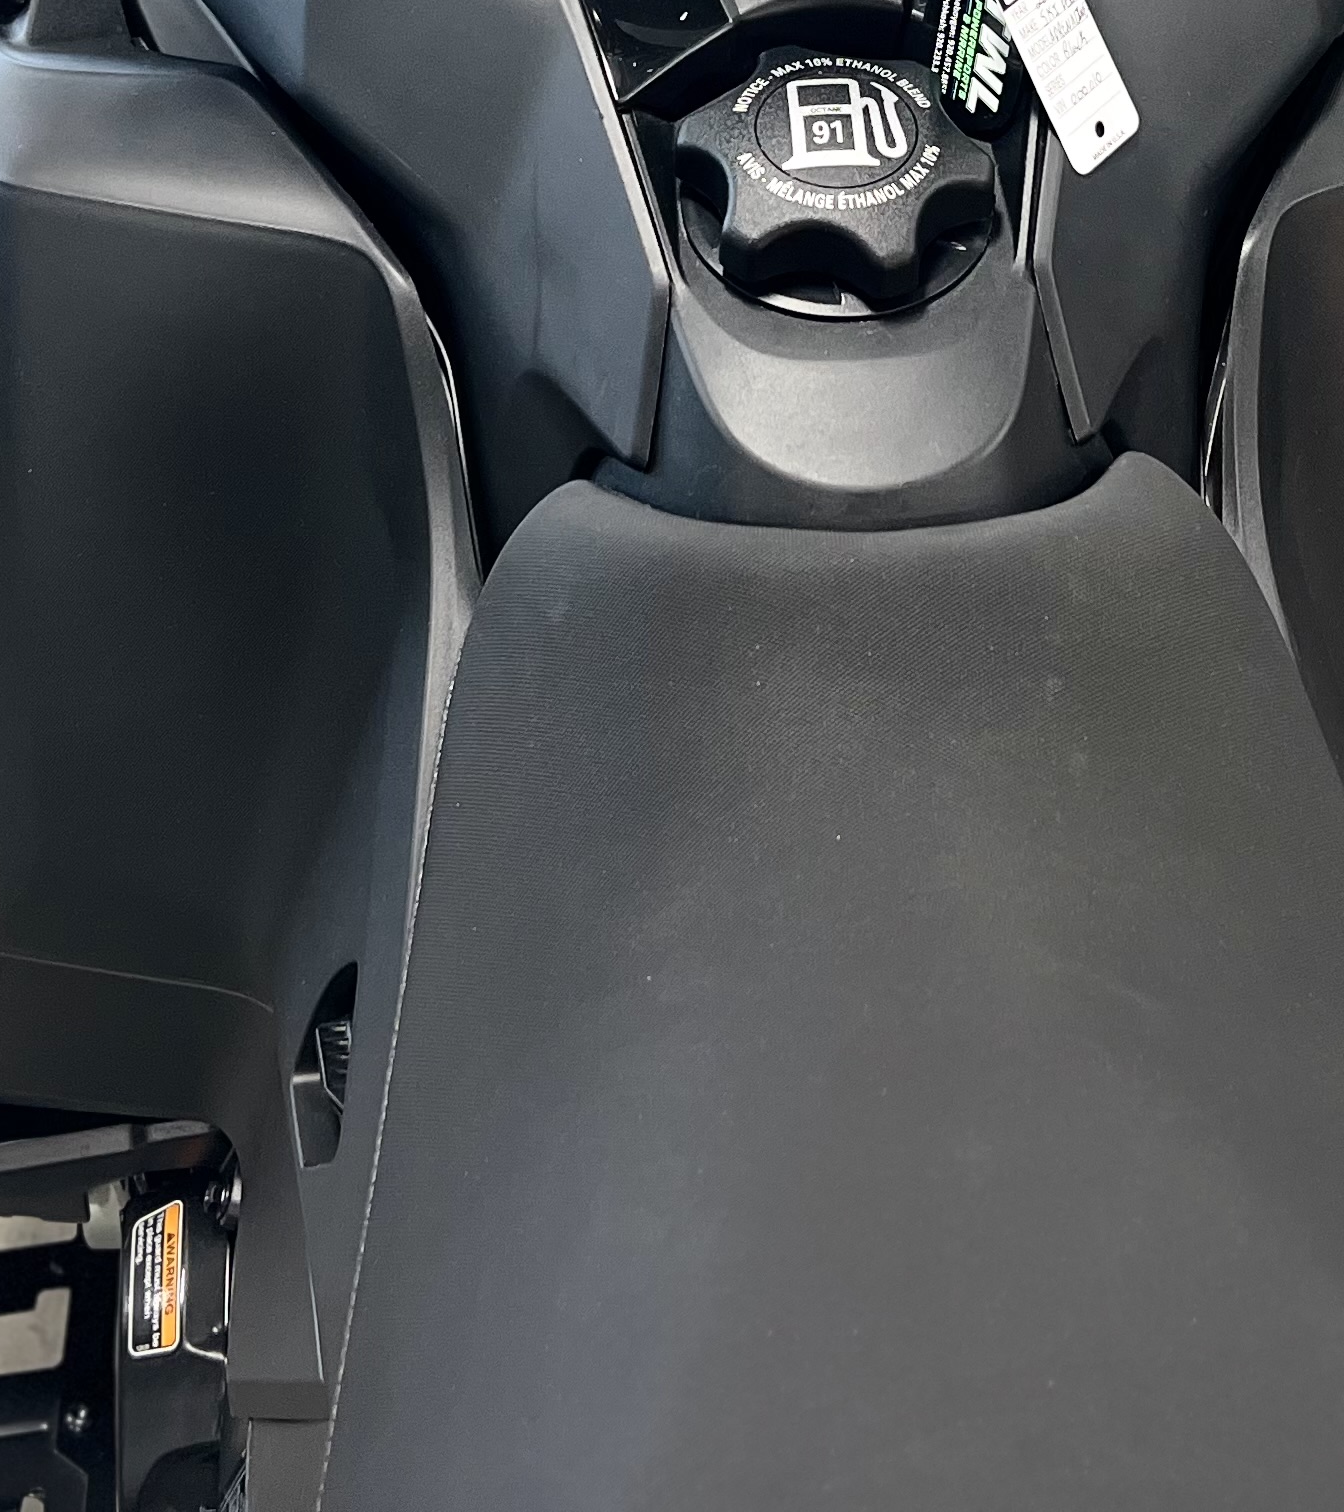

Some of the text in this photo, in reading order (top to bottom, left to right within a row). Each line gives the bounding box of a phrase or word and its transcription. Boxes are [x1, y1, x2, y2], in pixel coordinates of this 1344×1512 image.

[953, 25, 969, 80] MARINE
[958, 0, 983, 100] POWERSPORTS
[732, 78, 770, 112] NOTICE
[771, 61, 805, 77] MAX
[836, 58, 897, 82] ETHANOL
[896, 79, 930, 108] BLEND
[812, 120, 843, 144] 91
[737, 153, 765, 179] AVIS
[766, 177, 834, 209] MÉLANGE
[838, 183, 905, 210] ÉTHANOL
[899, 162, 929, 190] MAX
[165, 1242, 175, 1316] WARNING
